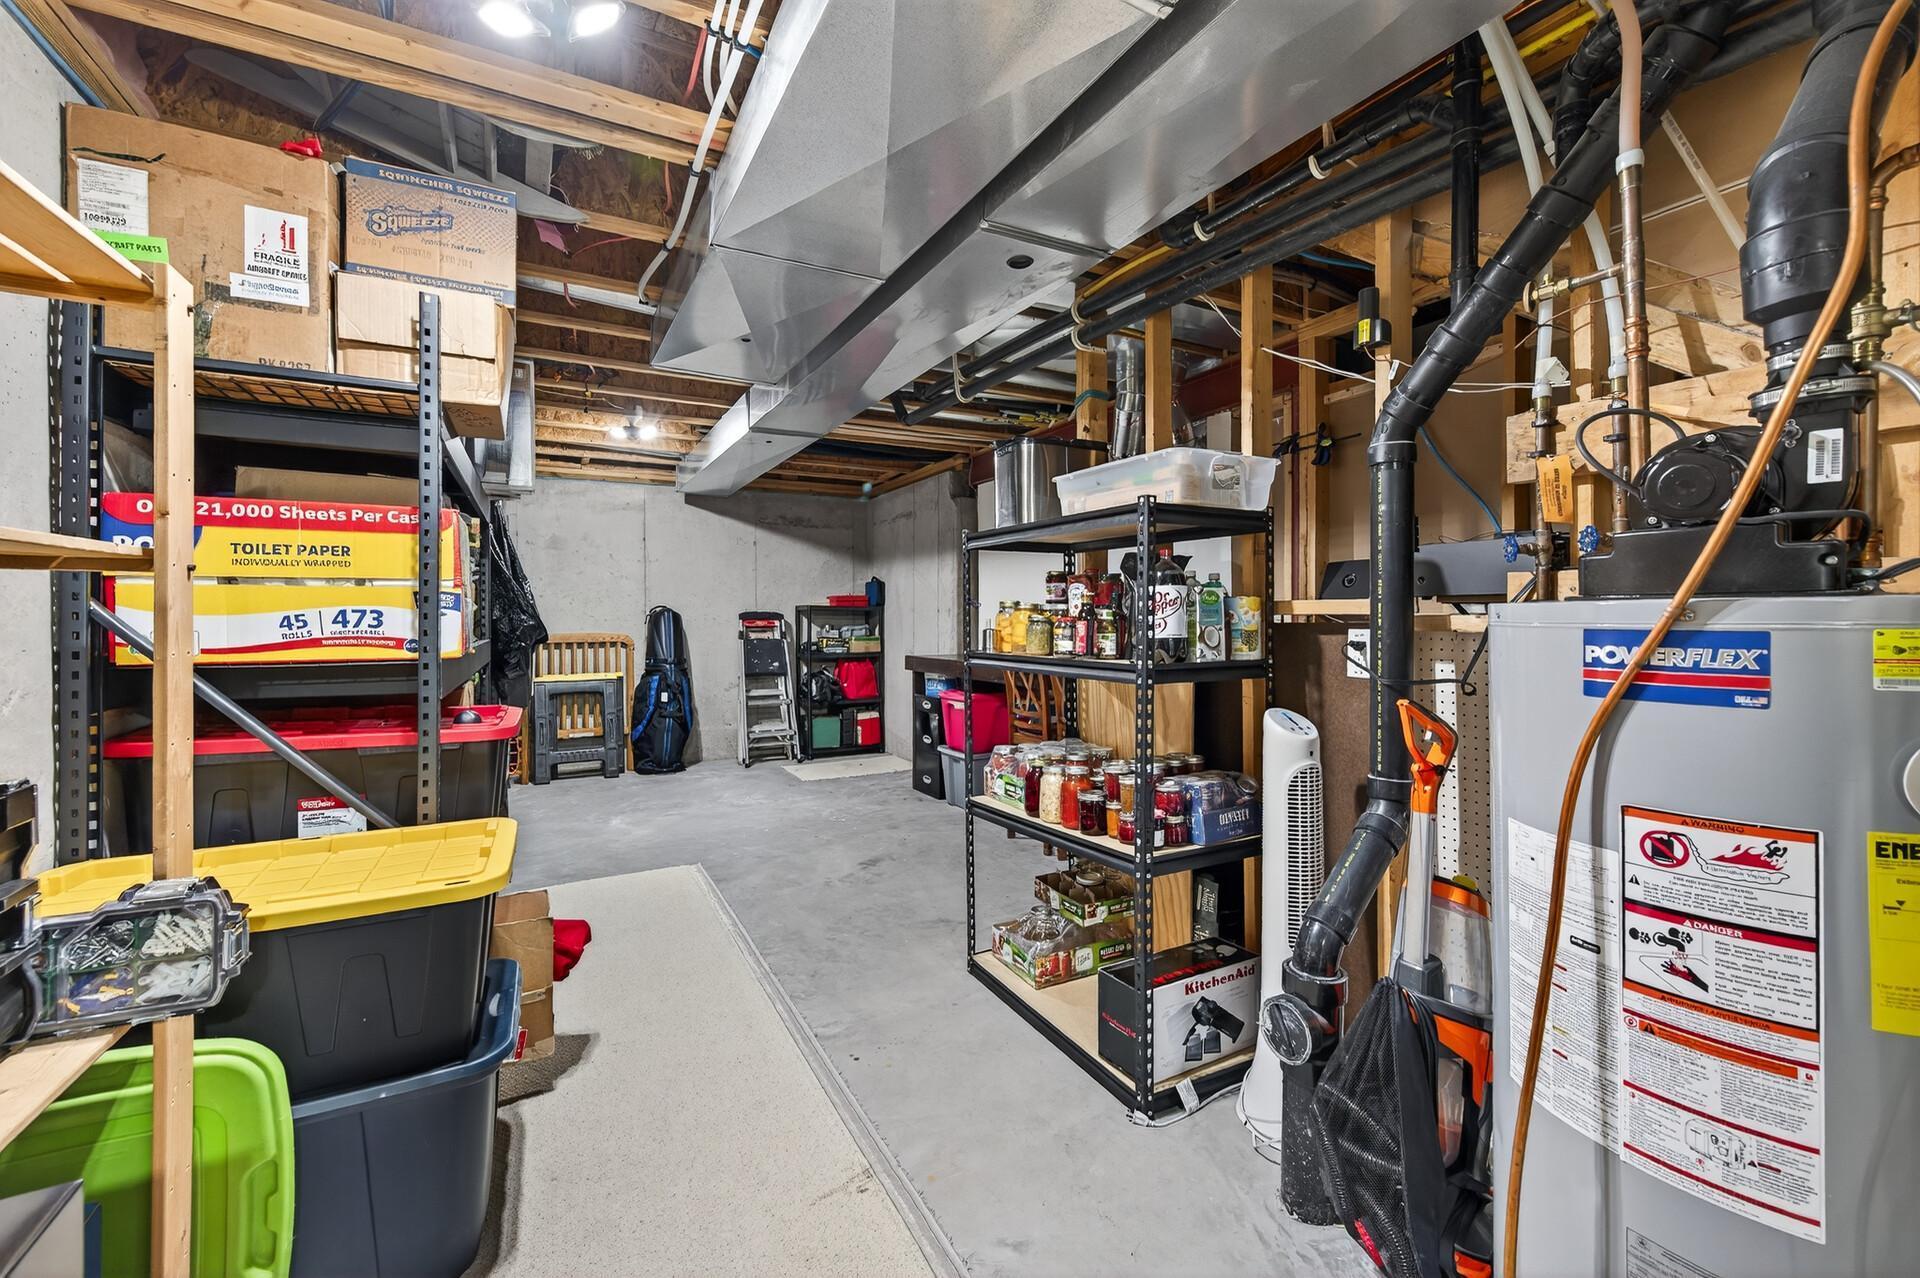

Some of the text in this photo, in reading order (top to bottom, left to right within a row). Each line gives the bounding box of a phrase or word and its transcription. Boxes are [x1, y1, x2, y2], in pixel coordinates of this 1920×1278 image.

[196, 502, 420, 524] 21,000 Sheets Per Cas
[230, 543, 351, 557] TOILET PAPER
[279, 613, 308, 632] 45
[331, 609, 384, 629] 473
[281, 631, 313, 640] ROLLS
[1689, 819, 1745, 834] WARNING
[1693, 922, 1744, 939] DANGER
[1184, 965, 1256, 995] KitchenAid
